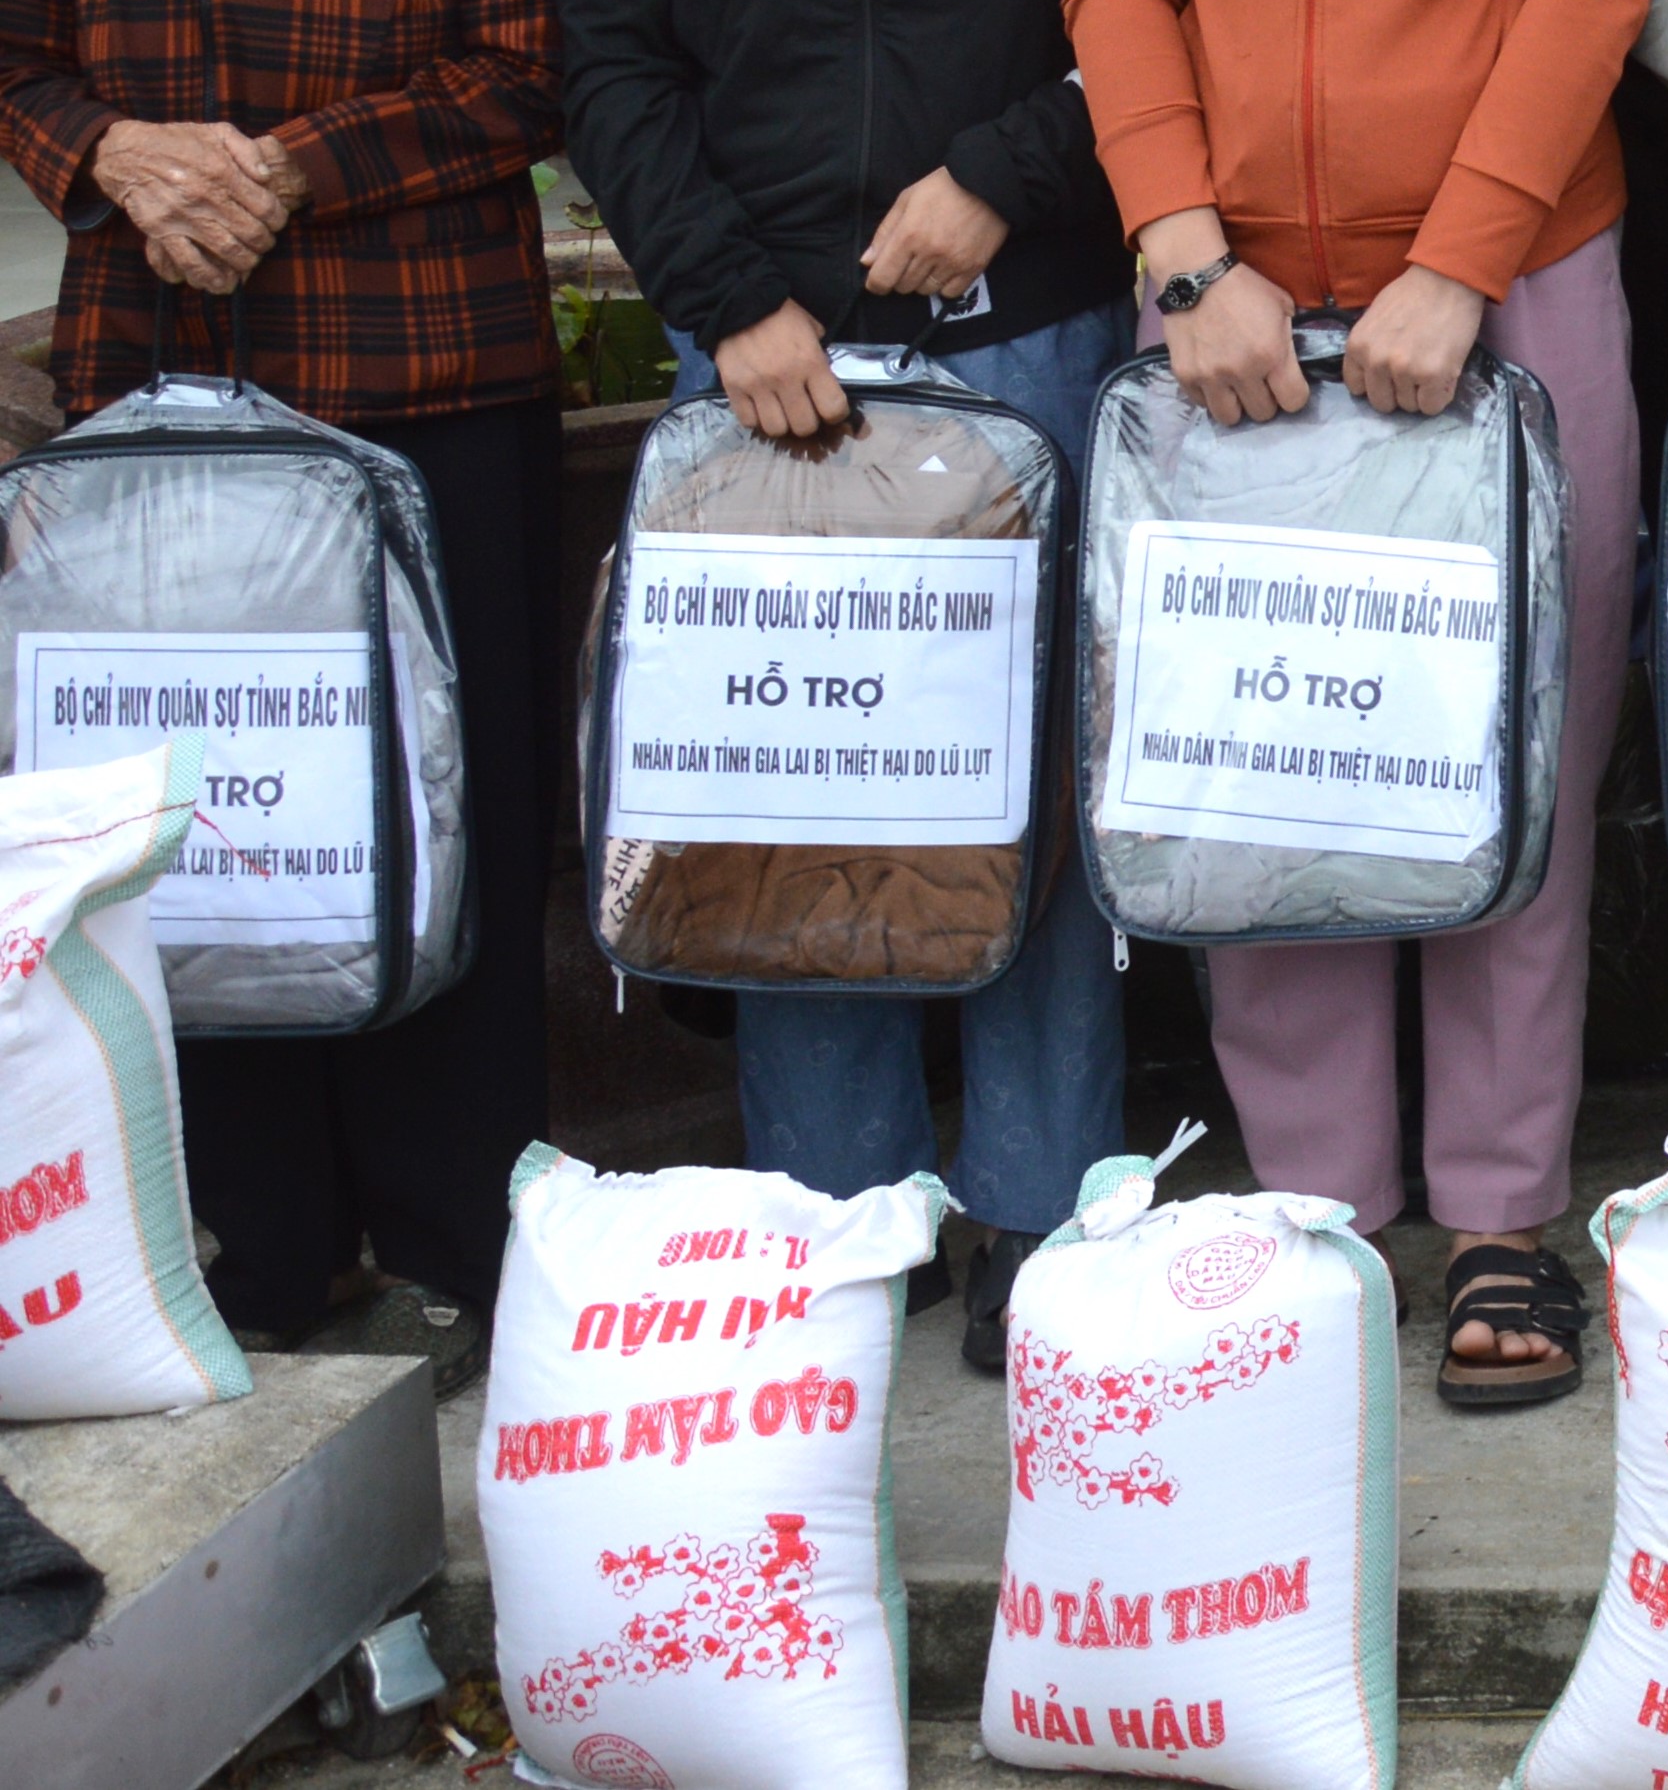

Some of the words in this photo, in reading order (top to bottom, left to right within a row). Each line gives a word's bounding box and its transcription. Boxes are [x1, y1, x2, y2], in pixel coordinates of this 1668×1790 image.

[644, 578, 669, 634] BỘ
[675, 573, 708, 626] CHỈ
[712, 586, 750, 627] HUY
[755, 581, 808, 632] QUÂN
[815, 587, 844, 638] SỰ
[848, 578, 891, 630] TỈNH
[898, 577, 937, 631] BẮC
[944, 592, 993, 631] NINH
[726, 661, 788, 706] HỖ
[803, 673, 884, 717] TRỢ
[1233, 655, 1290, 702] HỖ
[1305, 673, 1384, 720] TRỢ
[632, 738, 673, 771] NHÂN
[677, 739, 709, 773] DÂN
[715, 736, 750, 774] TỈNH
[755, 746, 780, 774] GIA
[786, 747, 809, 775] LAI
[815, 747, 830, 782] BỊ
[835, 743, 878, 782] THIỆT
[883, 748, 909, 783] HẠI
[914, 748, 936, 776] DO
[941, 743, 960, 776] LŨ
[965, 748, 992, 782] LỤT
[205, 770, 285, 816] TRỢ
[658, 1229, 749, 1267] 10KG
[571, 1292, 708, 1356] HẬU
[623, 1386, 738, 1466] TÁM
[749, 1363, 860, 1436] GẠO
[1051, 1578, 1153, 1650] TÁM
[1164, 1556, 1312, 1644] THƠM
[1012, 1682, 1094, 1748] HẢI
[1107, 1697, 1227, 1760] HẬU
